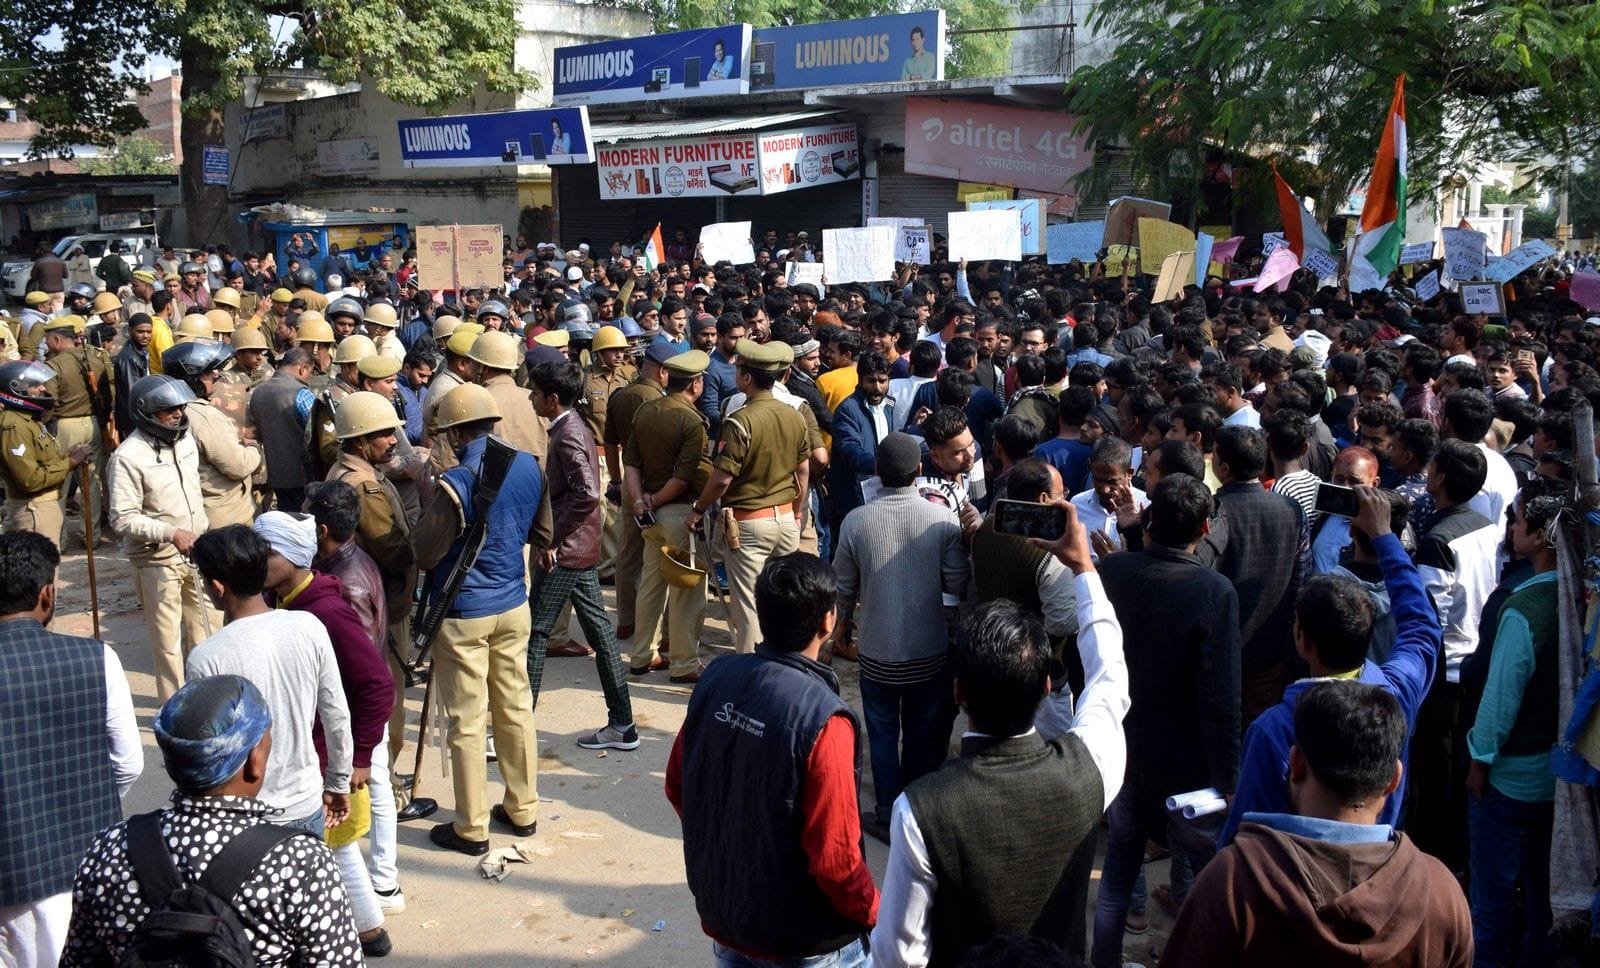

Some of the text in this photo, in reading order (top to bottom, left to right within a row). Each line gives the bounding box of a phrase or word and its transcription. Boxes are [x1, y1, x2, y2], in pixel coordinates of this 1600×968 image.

[795, 33, 890, 69] LUMINOUS
[559, 49, 634, 84] LUMINOUS
[404, 123, 472, 152] LUMINOUS
[763, 137, 804, 153] MODERN
[806, 130, 856, 148] FURNITURE
[949, 118, 1077, 160] airtel 4G
[600, 140, 756, 168] MODERN FURNITURE
[741, 163, 755, 177] MF
